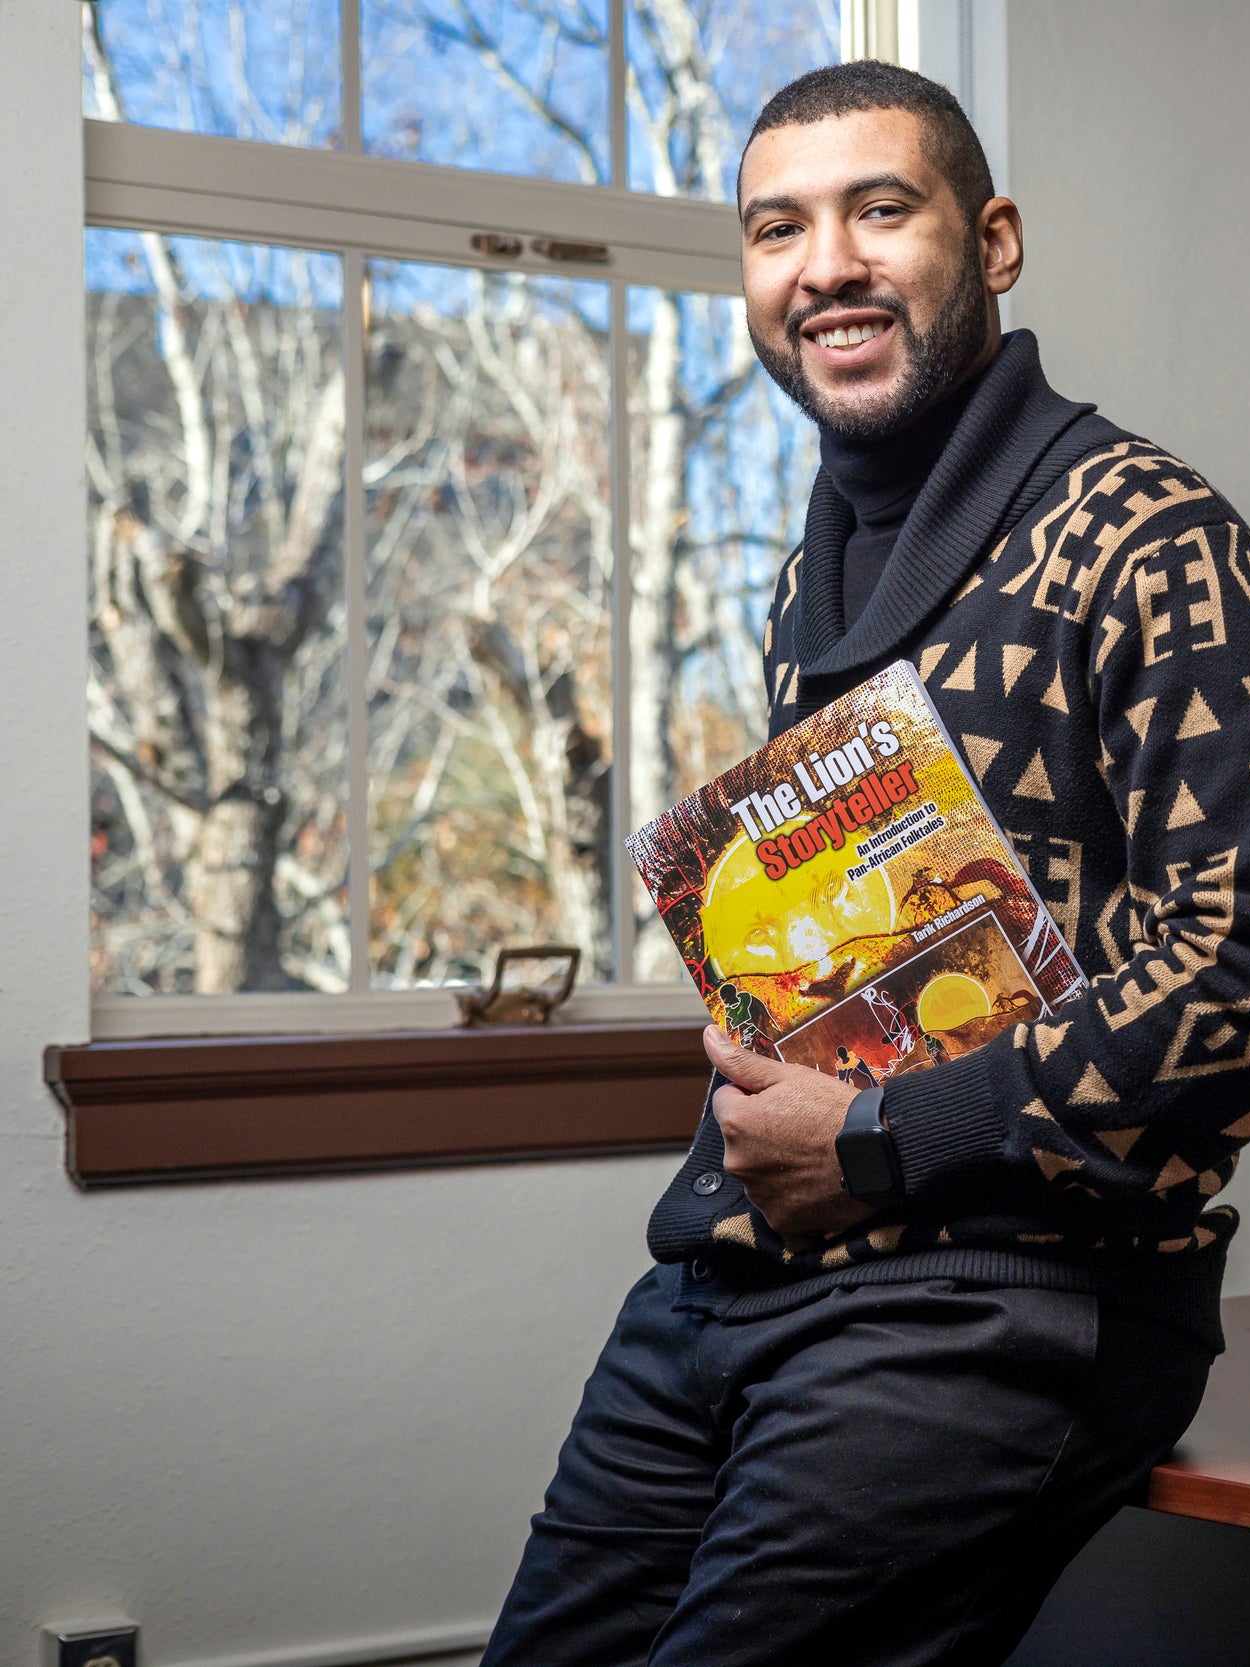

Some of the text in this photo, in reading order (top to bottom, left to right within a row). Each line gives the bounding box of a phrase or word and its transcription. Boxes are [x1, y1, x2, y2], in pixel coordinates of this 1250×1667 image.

[729, 721, 900, 842] The Lion's
[756, 760, 919, 881] Storyteller
[846, 816, 945, 881] Pan-African Folktales
[856, 802, 937, 858] An Introduction to
[911, 894, 986, 944] Tarik Richardson
